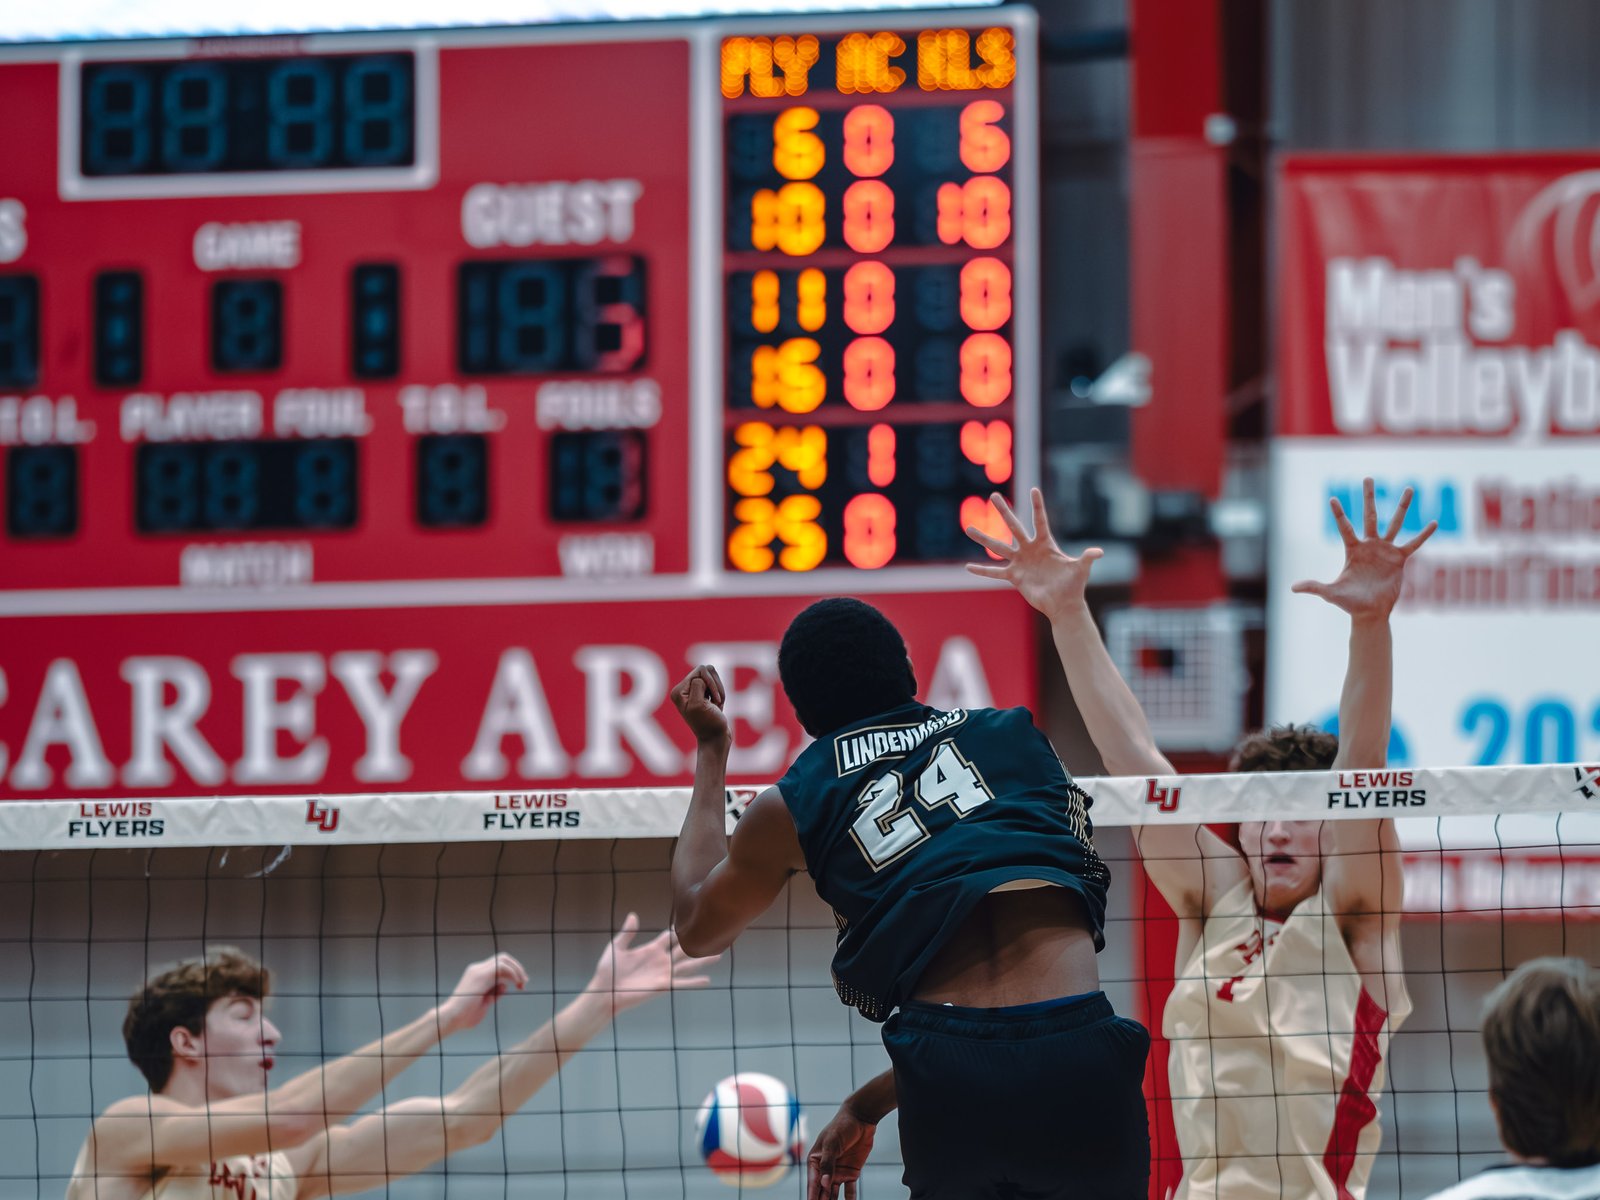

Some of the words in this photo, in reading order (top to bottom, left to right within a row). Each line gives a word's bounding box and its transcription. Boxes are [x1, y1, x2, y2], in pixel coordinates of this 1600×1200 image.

[773, 106, 826, 180] 6
[843, 104, 896, 177] 0
[959, 99, 1011, 173] 6
[461, 178, 644, 249] GUEST
[843, 179, 896, 253] 0
[751, 267, 827, 333] 11
[843, 260, 896, 335] 0
[959, 256, 1012, 331] 0
[1325, 254, 1515, 340] Men's
[843, 336, 896, 411] 0
[959, 332, 1012, 408] 0
[728, 420, 828, 497] 24
[867, 422, 897, 488] 1
[960, 419, 1013, 484] 4
[728, 493, 828, 573] 25
[843, 492, 897, 570] 0
[0, 650, 440, 790] AREY
[1458, 693, 1600, 765] 20
[80, 802, 153, 818] LEWIS
[494, 793, 569, 809] LEWIS
[848, 737, 995, 873] 24
[1326, 789, 1427, 810] FLYERS
[1338, 771, 1413, 789] LEWIS
[68, 819, 165, 838] FLYERS
[482, 810, 581, 830] FLYERS
